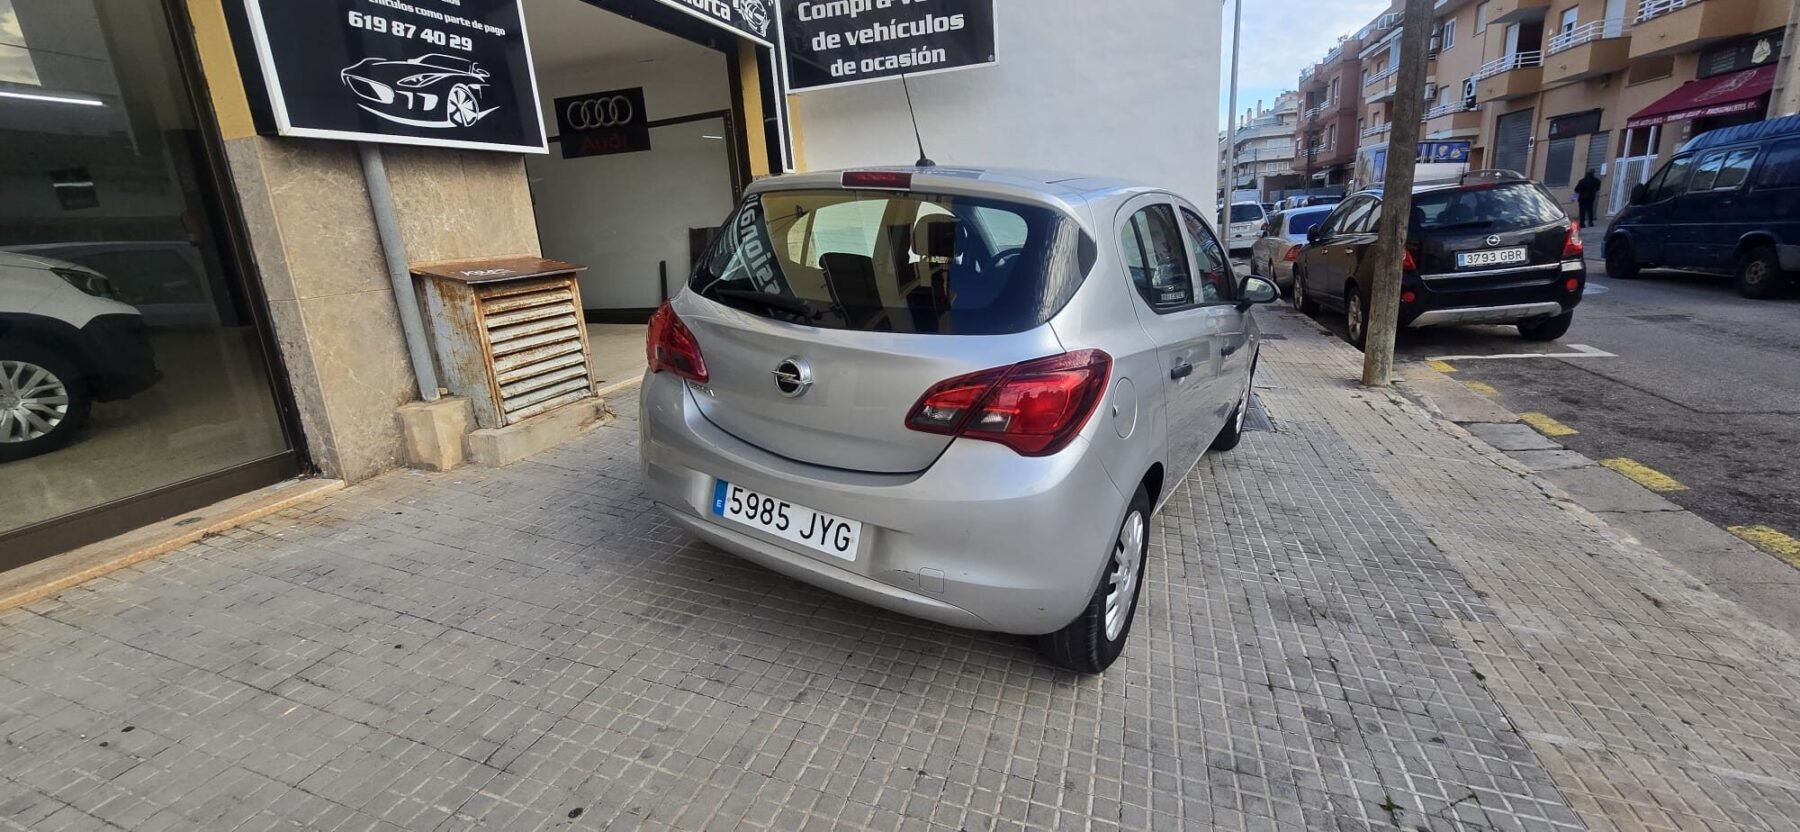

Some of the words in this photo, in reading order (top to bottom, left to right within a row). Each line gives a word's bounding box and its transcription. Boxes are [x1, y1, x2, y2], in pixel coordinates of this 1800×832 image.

[348, 10, 387, 33] 619
[391, 20, 417, 39] 87
[420, 28, 446, 46] 40
[449, 33, 473, 51] 29
[414, 6, 443, 20] como
[444, 14, 471, 27] parte
[471, 20, 484, 31] de
[483, 24, 506, 37] pago
[811, 31, 842, 51] de
[844, 13, 965, 46] vehículos
[830, 59, 857, 77] de
[860, 45, 946, 73] ocasión
[1466, 252, 1497, 264] 3793
[1500, 250, 1522, 261] GBR
[730, 486, 791, 531] 5985
[799, 512, 852, 552] JYG
